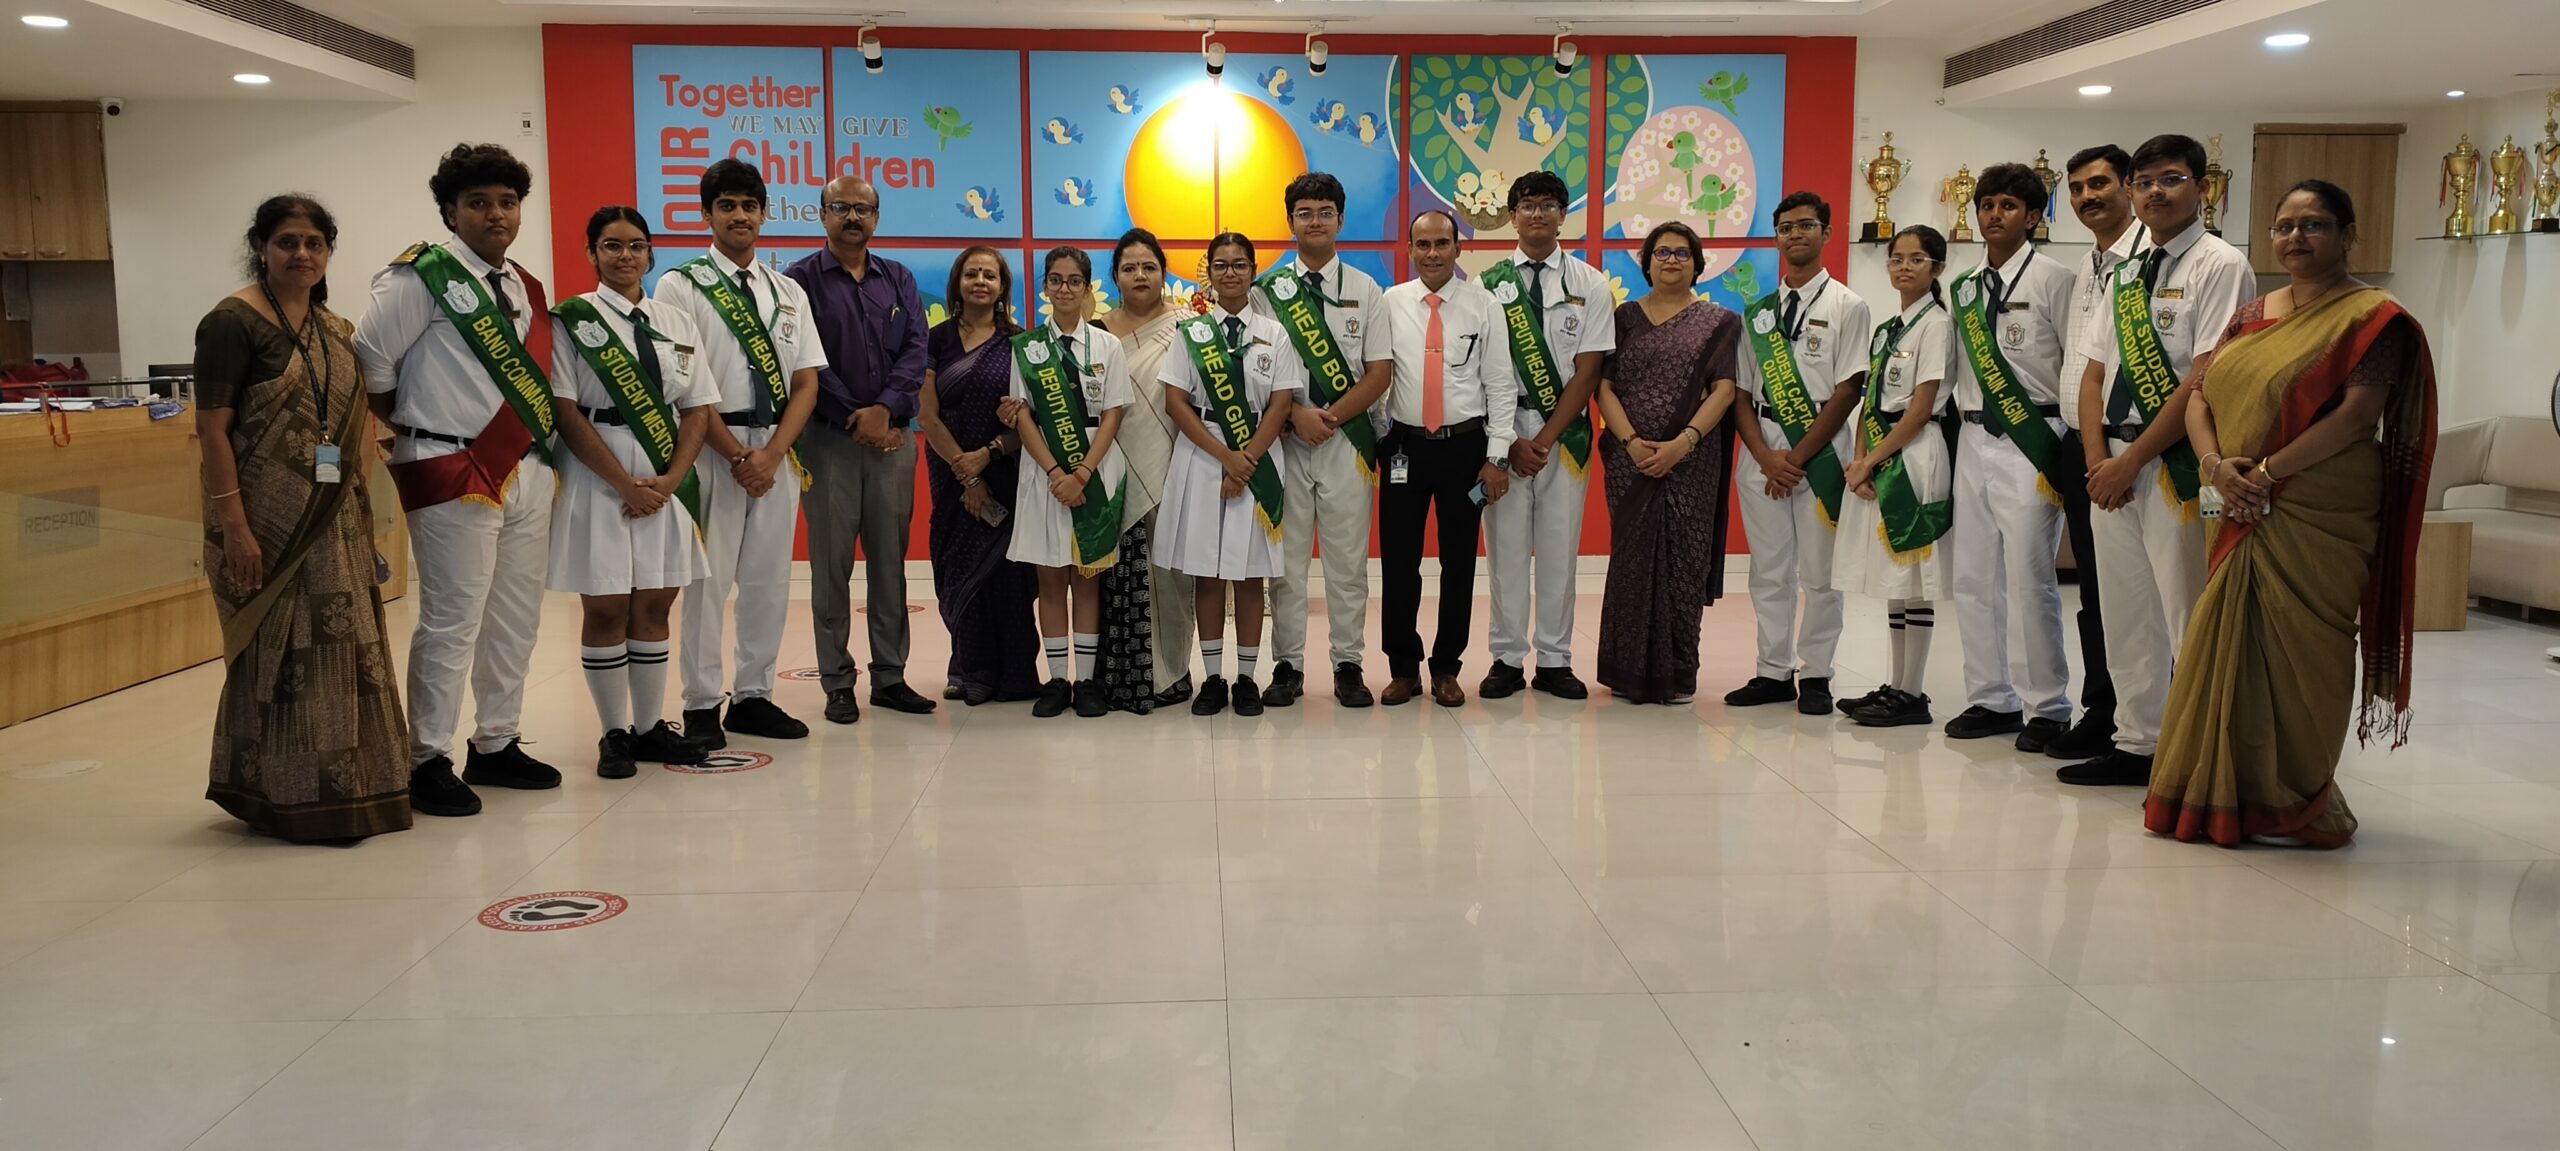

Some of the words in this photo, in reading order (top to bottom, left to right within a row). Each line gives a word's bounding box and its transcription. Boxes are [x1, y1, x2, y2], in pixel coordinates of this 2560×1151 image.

[658, 74, 821, 118] Together
[728, 114, 763, 134] WE
[773, 115, 824, 136] MAY
[841, 117, 910, 138] GIVE
[660, 126, 710, 231] OUR
[2130, 277, 2148, 321] CHIEF
[472, 314, 513, 360] BAND
[747, 334, 777, 373] HEAD
[768, 371, 786, 401] BOY
[1287, 301, 1330, 358] HEAD
[1322, 358, 1349, 393] BO
[1507, 305, 1537, 352] DEPUTY
[1525, 347, 1549, 392] HEAD
[1538, 386, 1560, 413] BOY
[1963, 308, 1985, 349] HOUSE
[1976, 345, 2010, 396] CAPTAIN
[1998, 395, 2030, 427] AGNI
[2118, 289, 2162, 412] CO-ORDINATOR
[1038, 366, 1069, 416] DEPUTY
[1200, 344, 1235, 402] HEAD
[1761, 360, 1798, 428] OUTREACH
[1768, 331, 1797, 390] STUDENT
[1788, 387, 1817, 432] CAPTA
[600, 346, 653, 412] STUDENT
[641, 409, 674, 463] MENTO
[1054, 413, 1081, 452] HEAD
[1067, 451, 1086, 471] GI
[24, 508, 97, 536] RECEPTION
